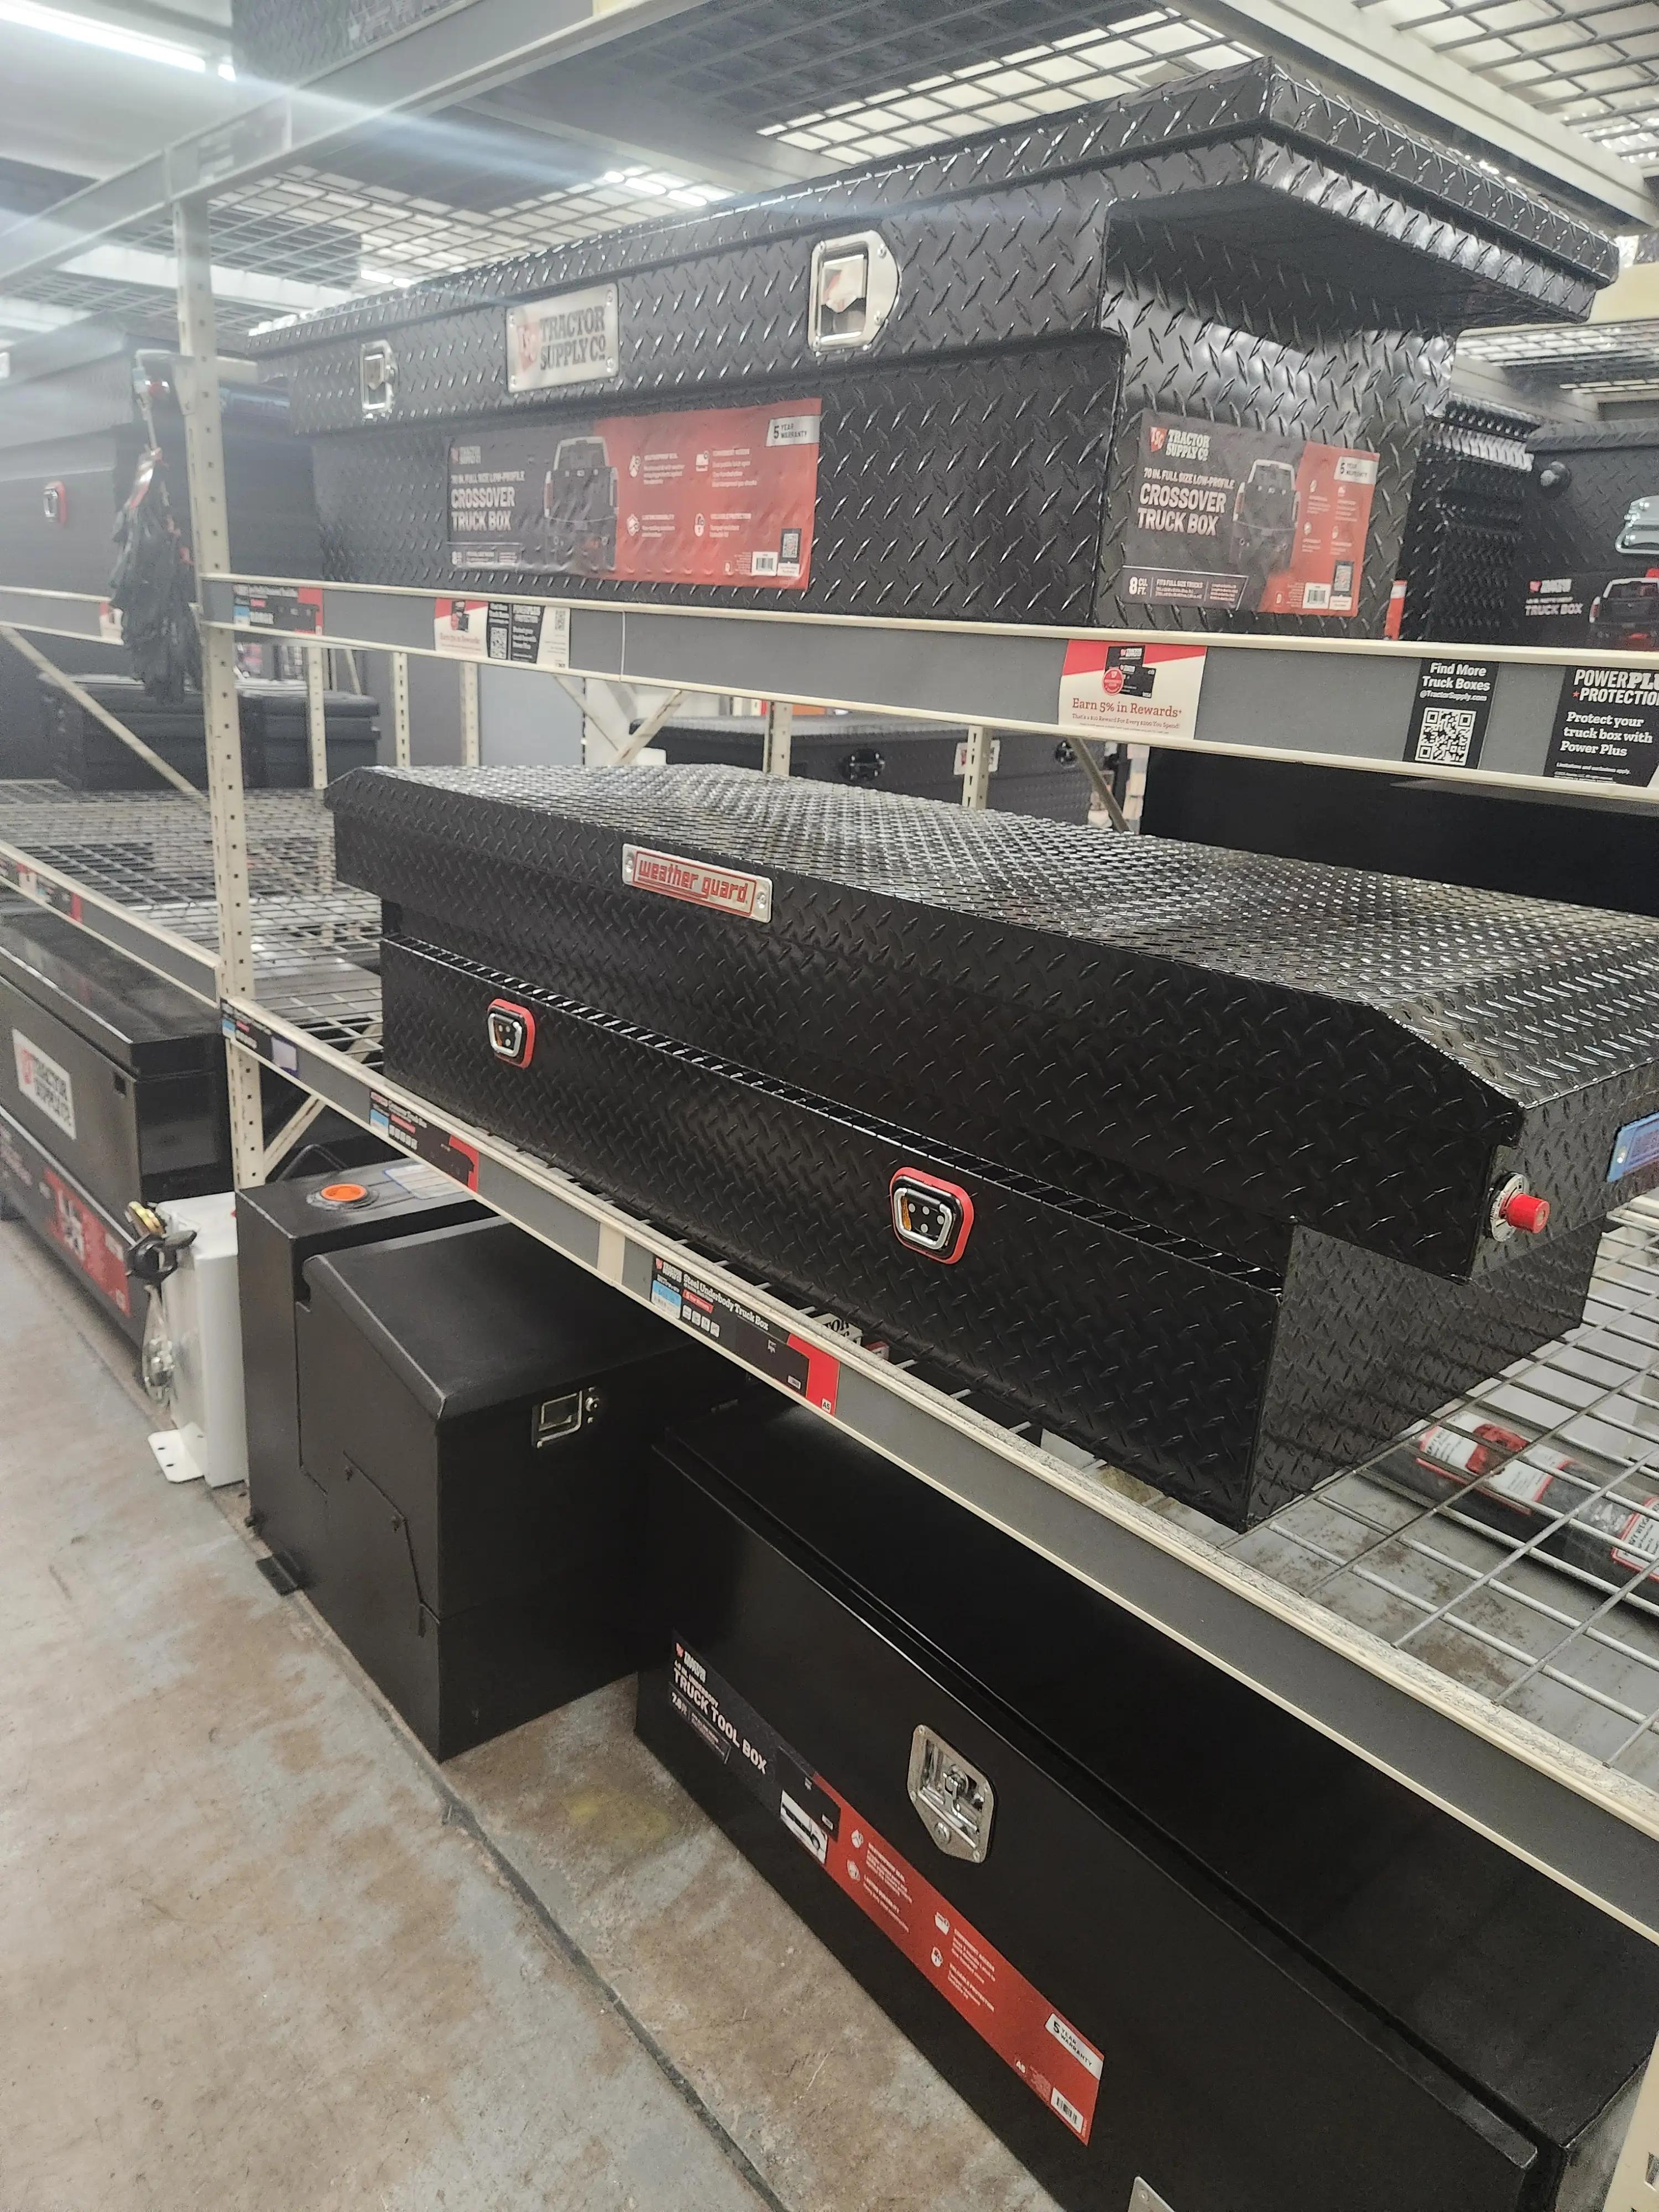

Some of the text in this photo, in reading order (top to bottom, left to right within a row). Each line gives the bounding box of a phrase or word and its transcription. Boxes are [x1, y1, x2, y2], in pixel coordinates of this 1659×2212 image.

[540, 305, 606, 342] TRACTOR
[540, 337, 588, 371] SUPPLY
[774, 425, 779, 439] 5
[1168, 429, 1211, 448] TRACTOR
[1166, 443, 1198, 460] SUPPLY
[1144, 467, 1152, 479] 70
[1161, 470, 1178, 482] FULL
[1193, 474, 1235, 489] LOW-PROFILE
[451, 486, 515, 508] CROSSOVER
[1140, 483, 1227, 513] CROSSOVER
[451, 510, 512, 531] TRUCK BOX
[1138, 508, 1219, 536] TRUCK BOX
[1129, 577, 1138, 594] 8
[1525, 603, 1583, 616] TRUCK BOX
[1430, 662, 1486, 676] Find More
[1422, 676, 1491, 691] Truck Boxes
[1072, 698, 1097, 711] Earn
[1100, 702, 1114, 713] 5%
[1117, 701, 1128, 713] in
[1420, 690, 1487, 702] @TractorSupply.com
[1566, 712, 1645, 728] Protect your
[1563, 727, 1653, 743] truck box with
[1560, 740, 1627, 757] Power Plus
[639, 860, 748, 903] weather guard
[684, 1274, 700, 1291] Steel
[700, 1283, 734, 1312] Underbody
[733, 1303, 756, 1323] Truck
[755, 1316, 769, 1331] Box
[674, 1667, 709, 1715] TRUCK
[711, 1706, 740, 1748] TOOL
[742, 1739, 767, 1775] BOX
[1053, 2021, 1077, 2045] 5 YEAR
[1061, 2034, 1092, 2067] WARRANTY
